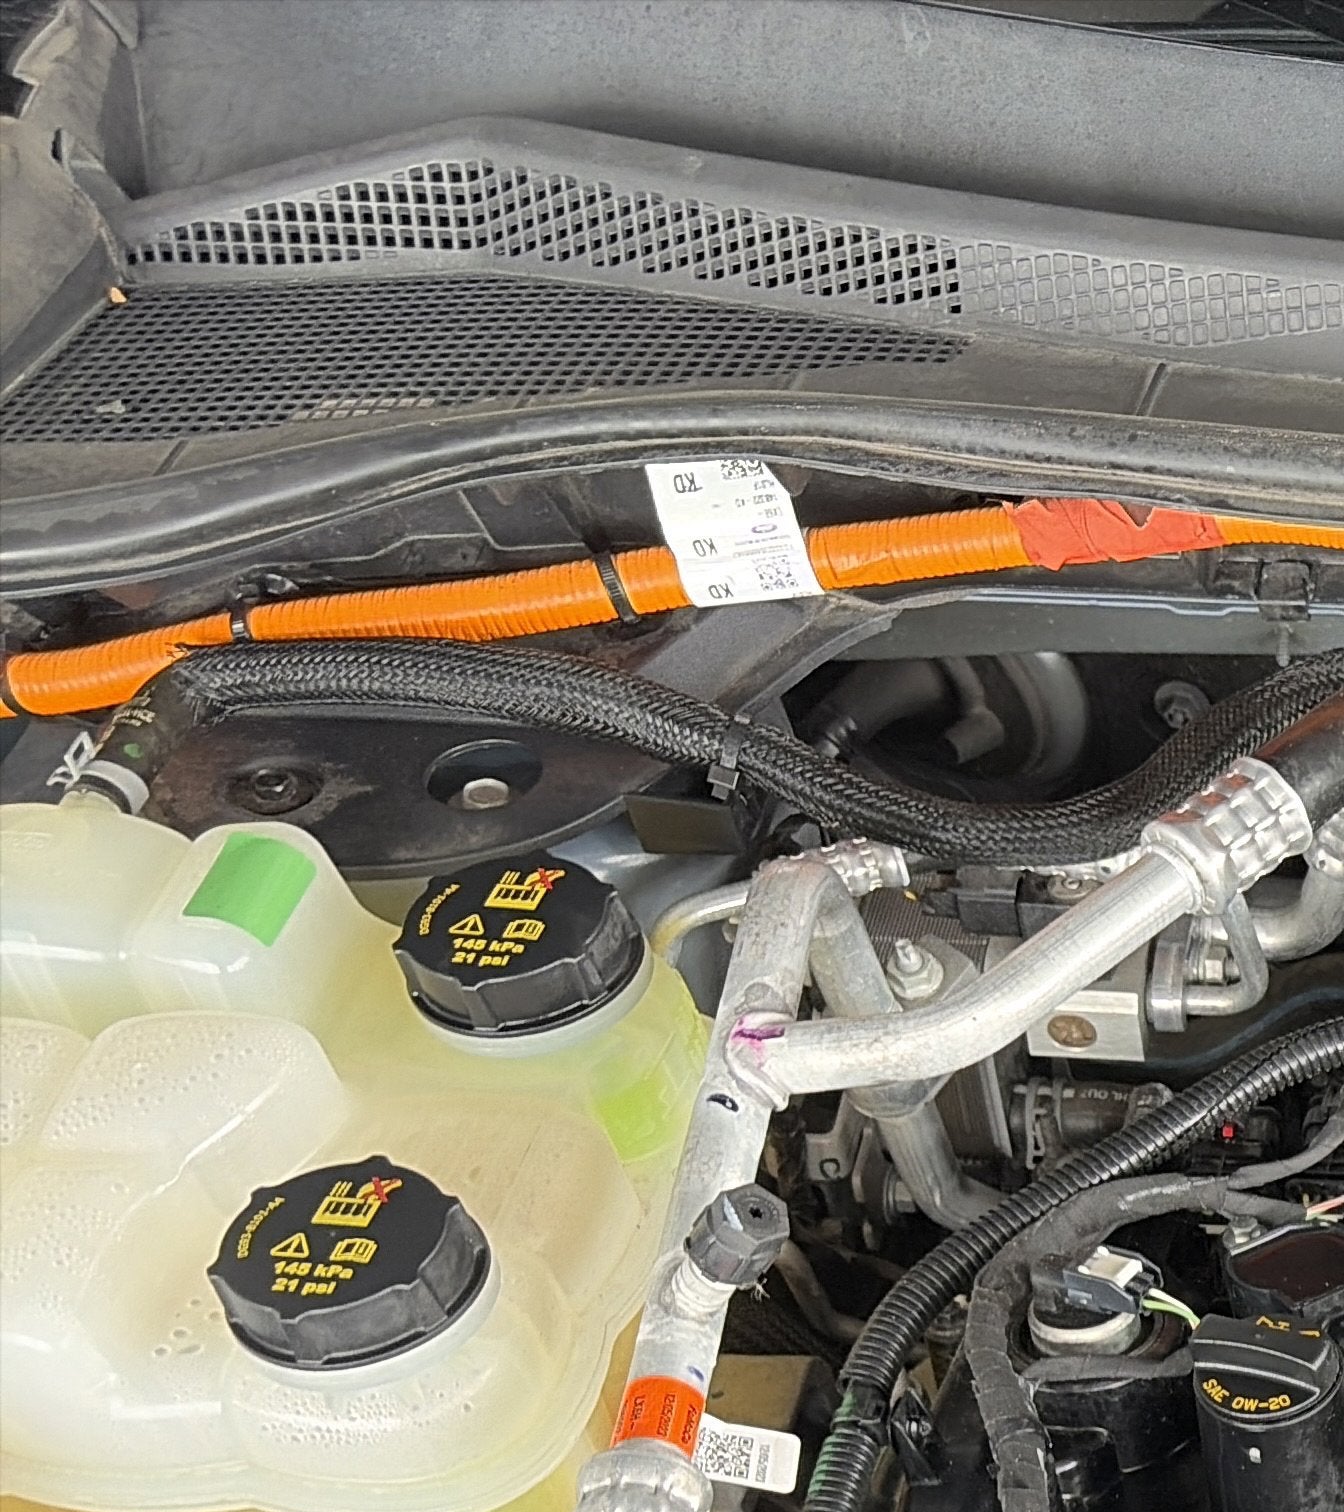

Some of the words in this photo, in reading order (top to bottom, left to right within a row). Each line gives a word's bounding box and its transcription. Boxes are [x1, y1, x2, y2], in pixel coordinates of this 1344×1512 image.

[674, 472, 702, 493] KD
[692, 537, 718, 557] KD
[708, 582, 734, 600] KD
[452, 938, 484, 951] 145
[489, 940, 525, 955] kPa
[451, 952, 477, 964] 21
[478, 954, 511, 968] psi
[274, 1261, 312, 1276] 145
[313, 1264, 354, 1280] kPa
[271, 1278, 300, 1293] 21
[301, 1281, 337, 1296] psi
[1202, 1378, 1230, 1403] SAE
[1231, 1394, 1291, 1412] 0W-20
